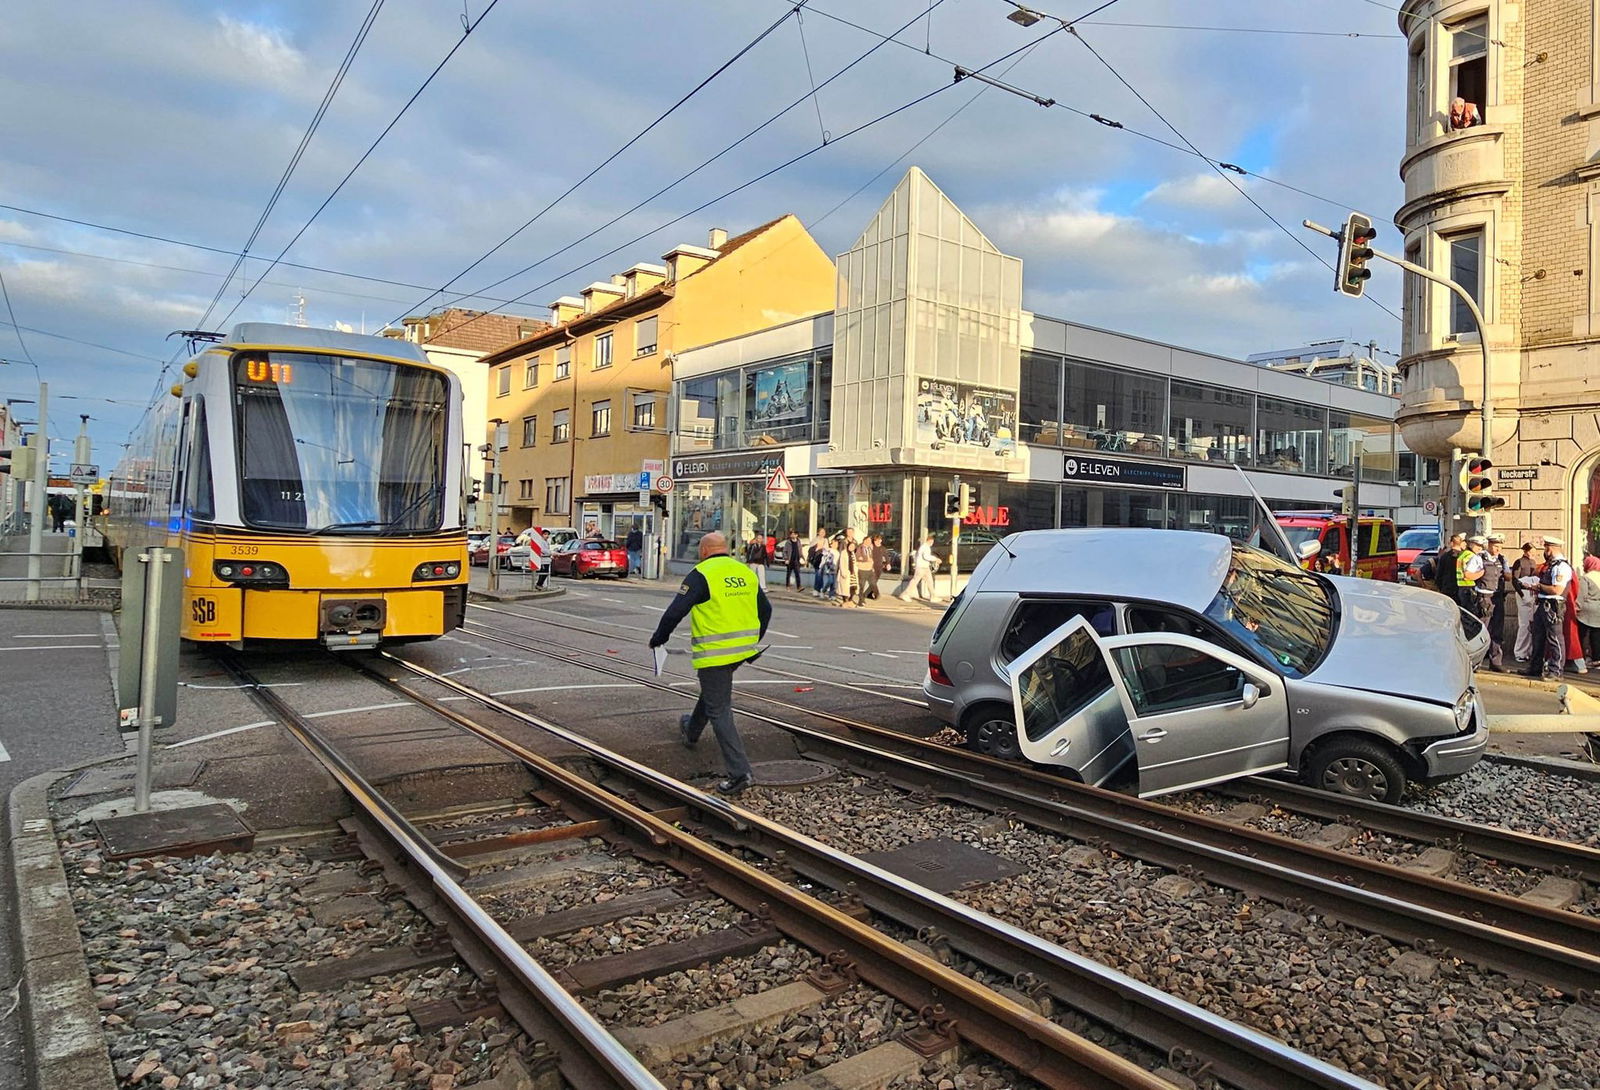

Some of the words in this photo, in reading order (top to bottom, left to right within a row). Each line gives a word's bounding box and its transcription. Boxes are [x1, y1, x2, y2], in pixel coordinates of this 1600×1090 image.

[247, 360, 292, 384] U11
[1501, 470, 1537, 479] Neckarstr.
[659, 479, 670, 489] 30
[963, 506, 1010, 527] SALE
[230, 545, 259, 556] 3539
[724, 576, 747, 588] SSB
[191, 597, 215, 624] SSB
